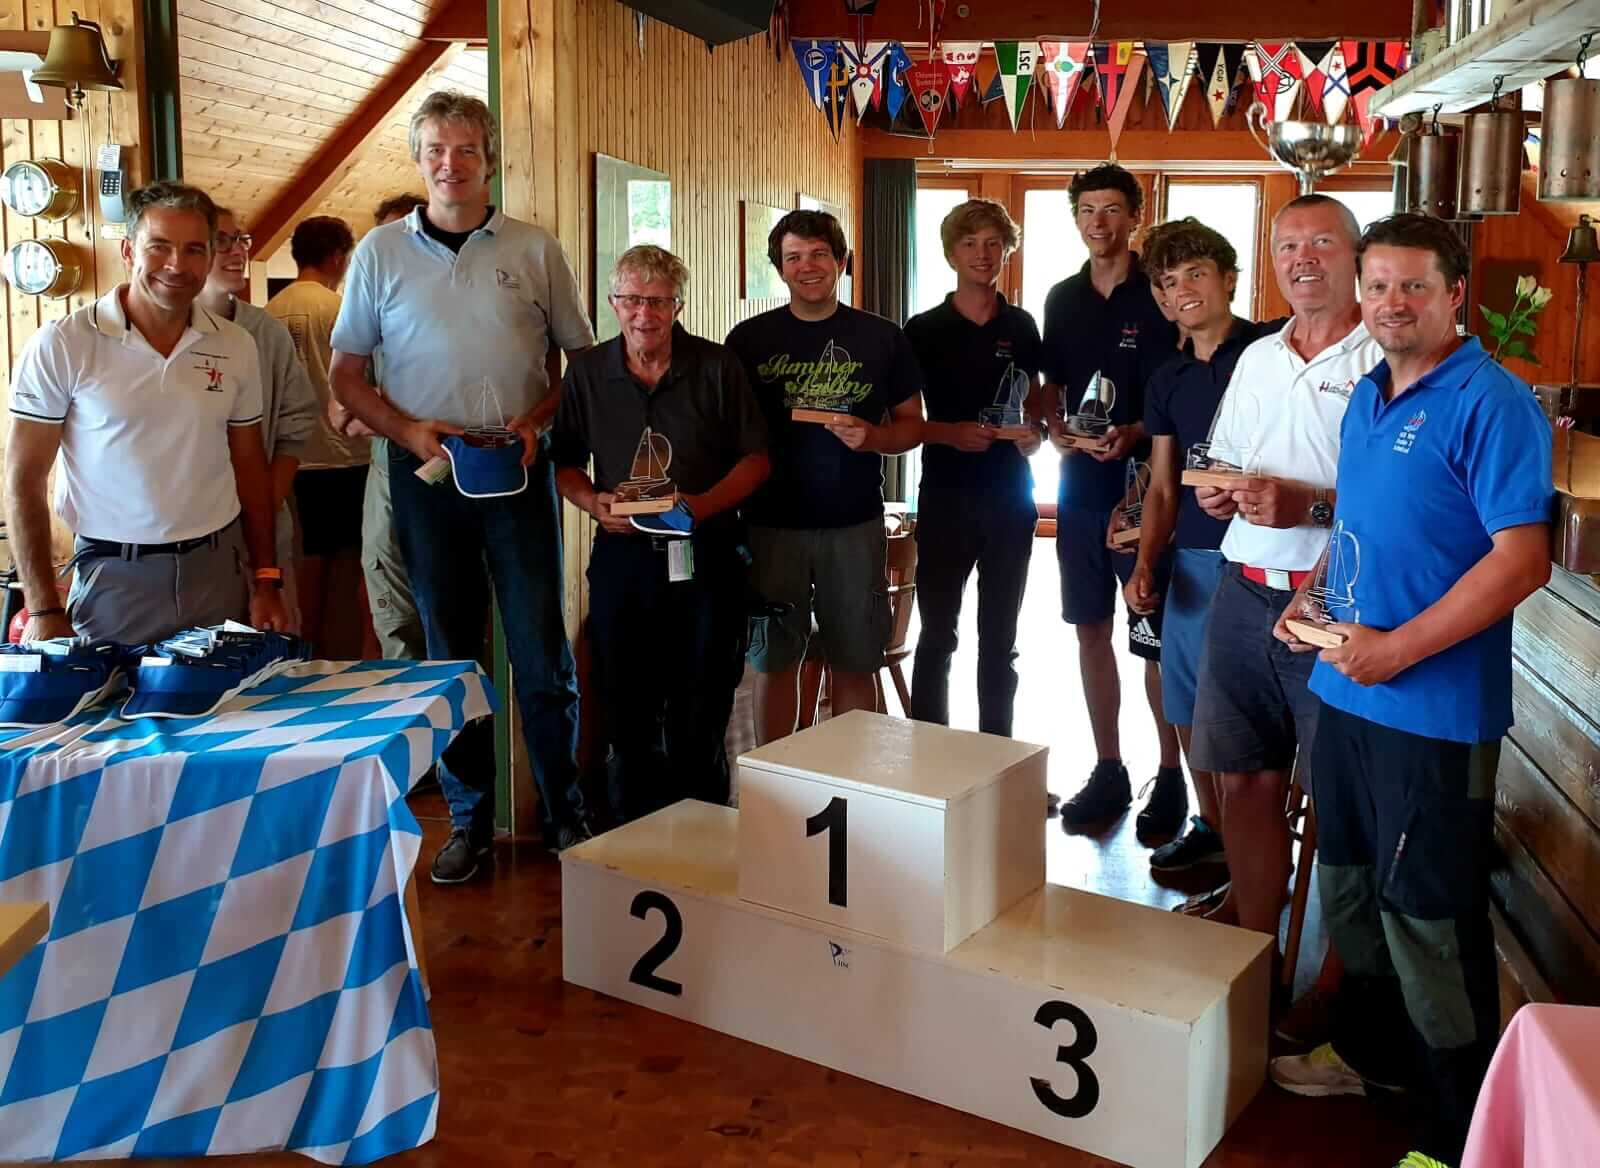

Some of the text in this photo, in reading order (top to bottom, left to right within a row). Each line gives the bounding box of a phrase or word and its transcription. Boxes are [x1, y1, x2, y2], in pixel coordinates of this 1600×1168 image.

[1019, 50, 1031, 71] LSC
[757, 353, 863, 383] Summer
[1130, 631, 1162, 648] adidas
[806, 796, 848, 908] 1
[628, 890, 683, 996] 2
[1029, 1000, 1100, 1118] 3
